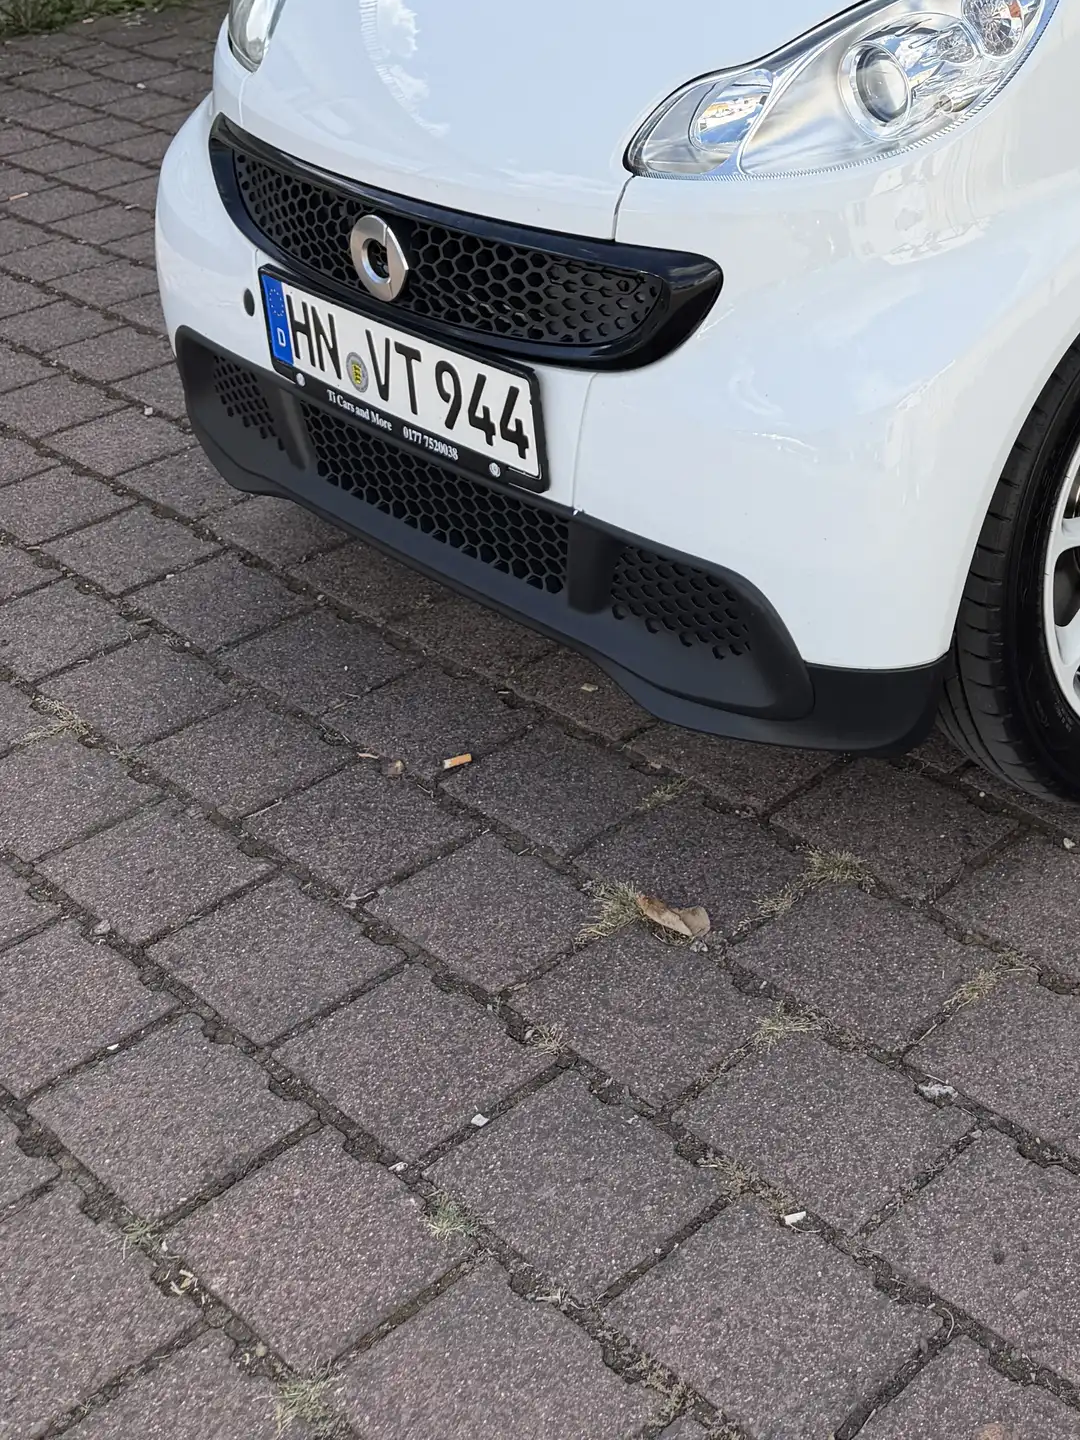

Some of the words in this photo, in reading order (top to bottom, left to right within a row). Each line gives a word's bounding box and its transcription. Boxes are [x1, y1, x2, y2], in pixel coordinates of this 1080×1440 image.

[285, 294, 342, 380] HN
[365, 329, 422, 416] VT
[435, 360, 530, 460] 944
[337, 395, 355, 412] Cars
[355, 406, 370, 421] and
[370, 411, 393, 431] More
[403, 426, 422, 444] 0177
[423, 435, 459, 461] 7520038
